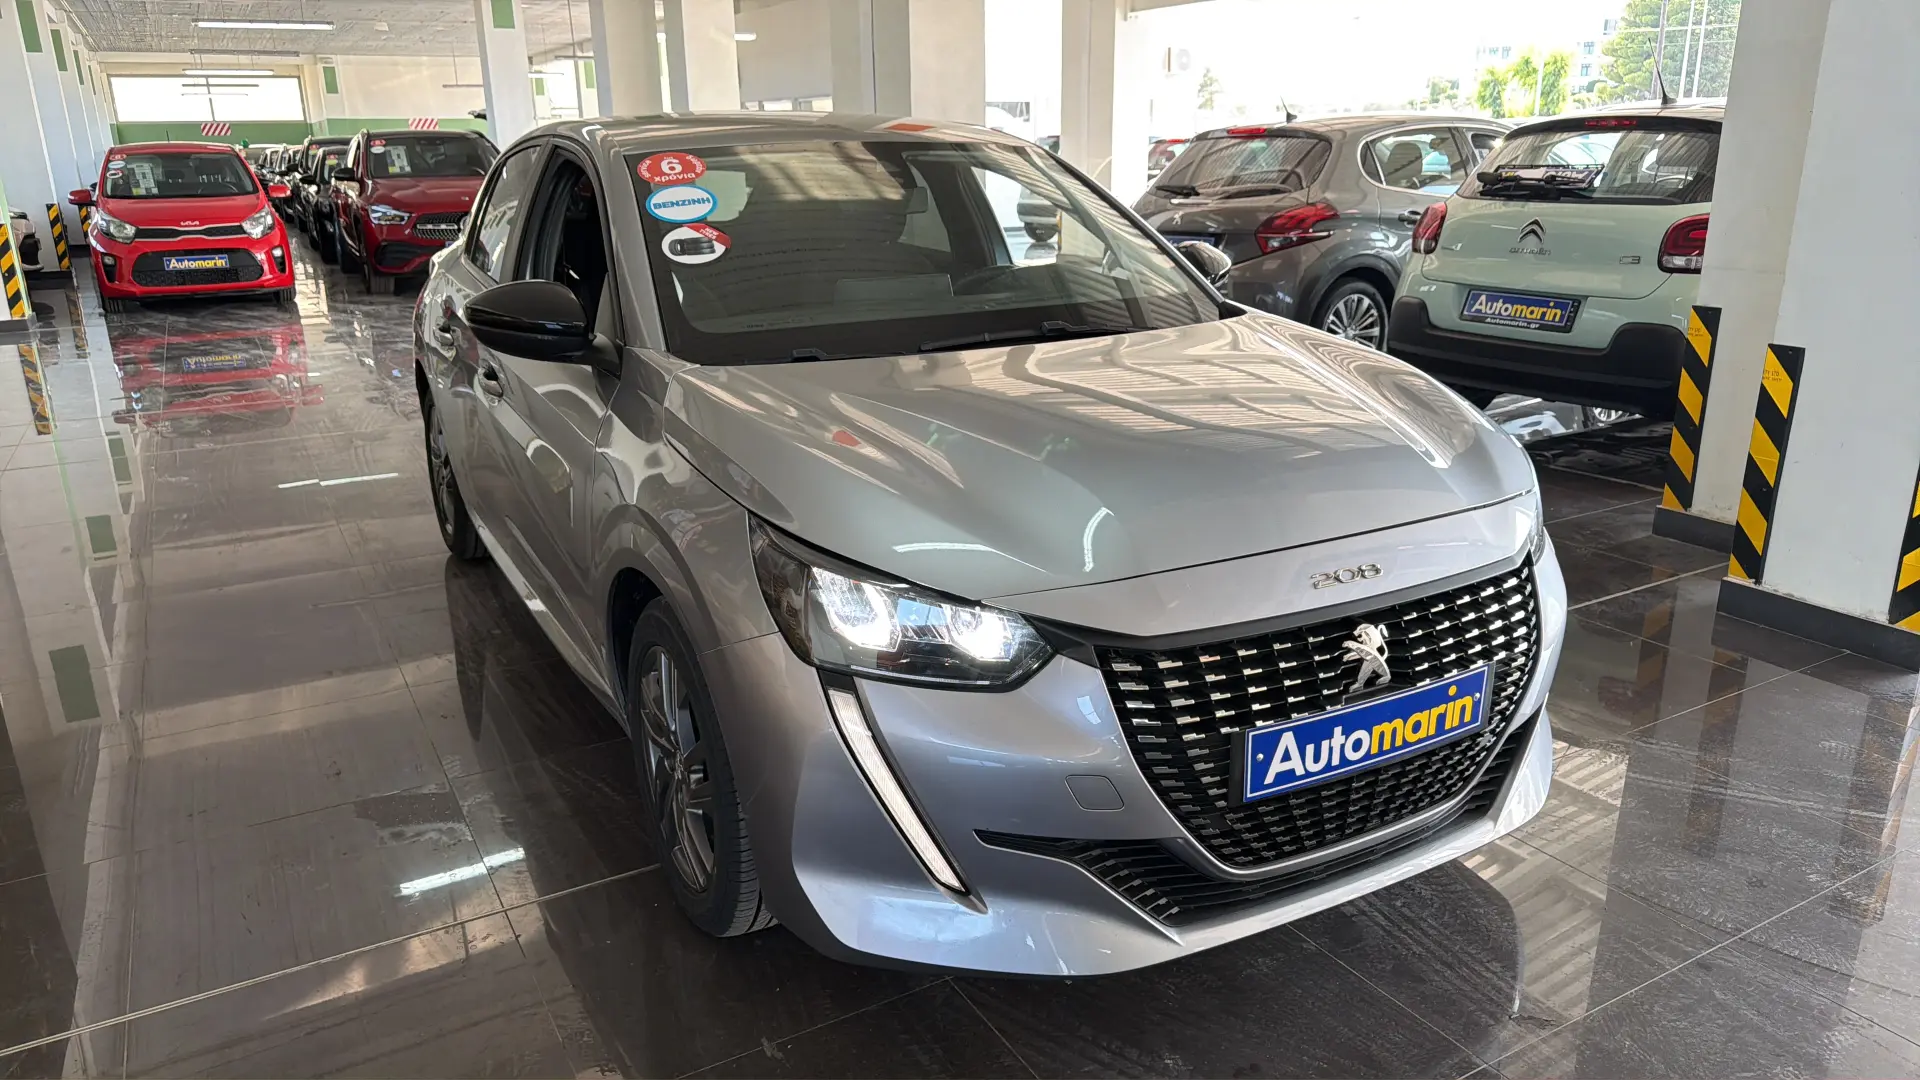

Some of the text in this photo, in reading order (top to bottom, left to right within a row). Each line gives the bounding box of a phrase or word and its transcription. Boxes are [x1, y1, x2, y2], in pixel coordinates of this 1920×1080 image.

[660, 158, 683, 174] 6
[653, 172, 696, 182] χρόνια
[169, 257, 226, 269] Automarin
[1471, 294, 1562, 323] Automarin
[1485, 317, 1540, 329] Automarin.gr
[1311, 563, 1384, 589] 208
[1264, 685, 1473, 785] Automarin
